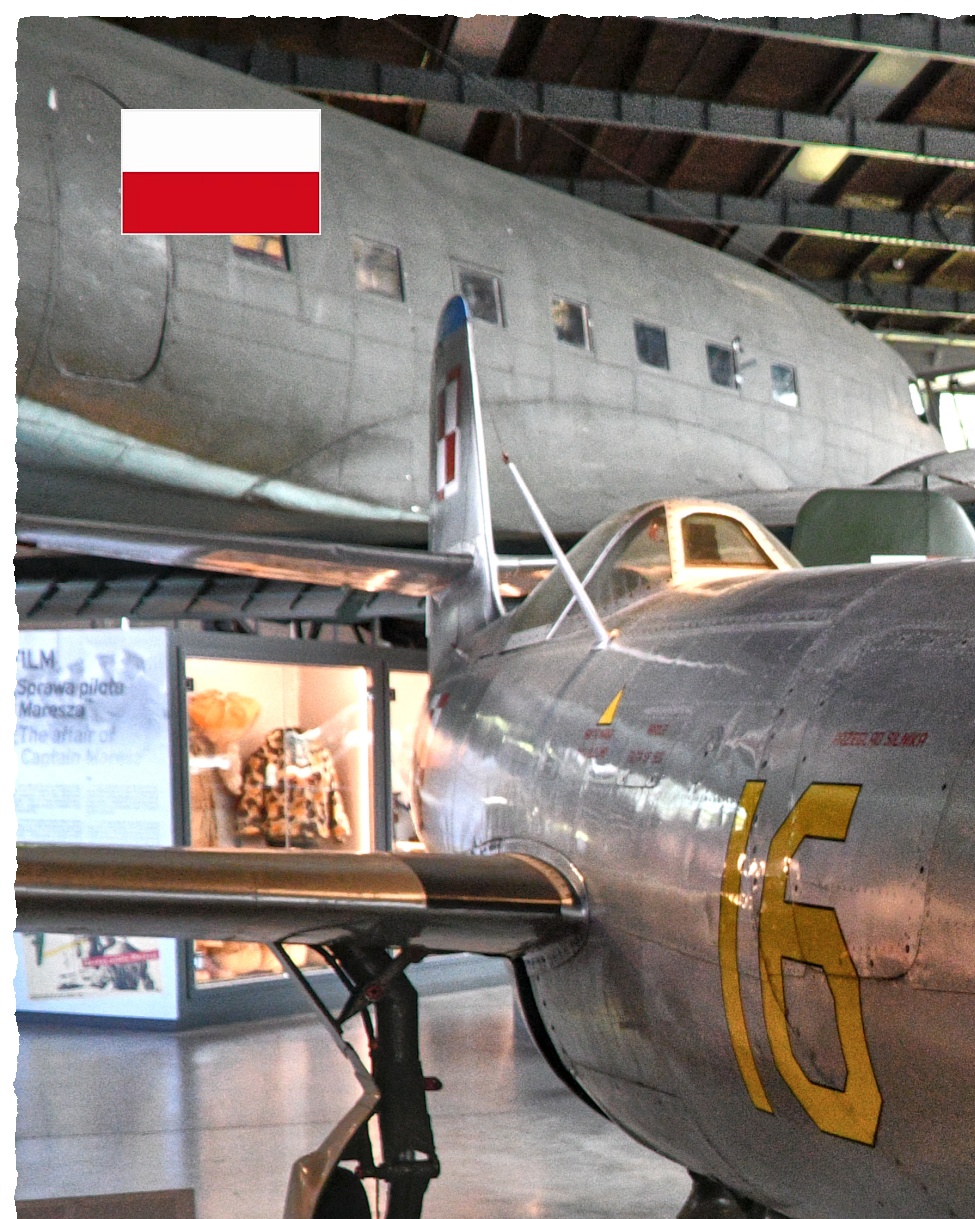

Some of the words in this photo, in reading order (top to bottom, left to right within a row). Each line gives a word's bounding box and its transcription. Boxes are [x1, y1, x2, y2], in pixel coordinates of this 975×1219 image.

[17, 678, 75, 697] Sprawa
[79, 677, 125, 698] pilota
[19, 702, 86, 719] Maresza
[19, 724, 48, 743] The
[718, 779, 882, 1147] 16
